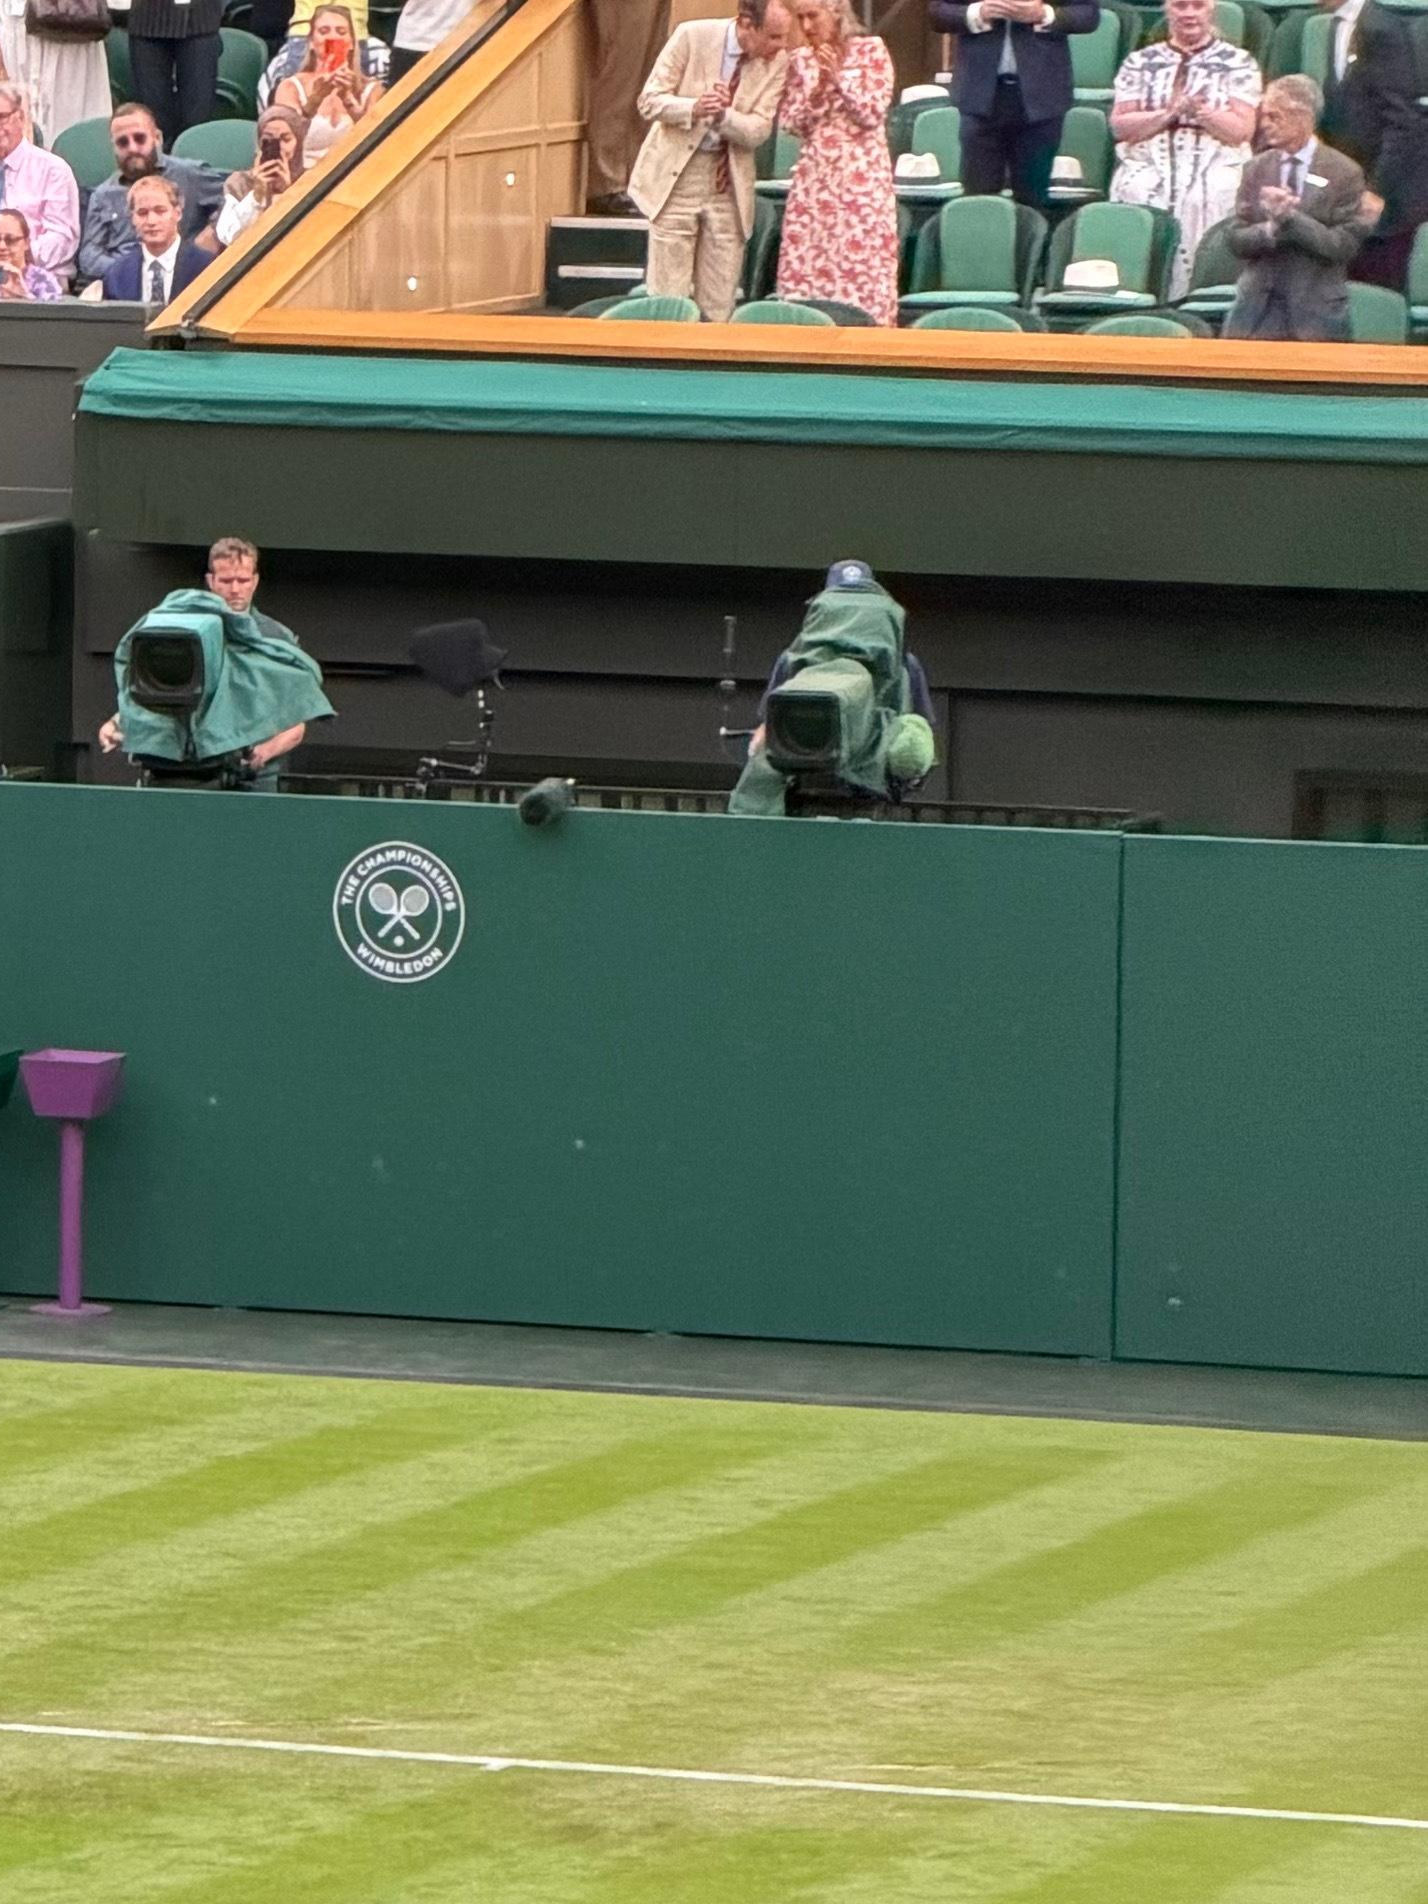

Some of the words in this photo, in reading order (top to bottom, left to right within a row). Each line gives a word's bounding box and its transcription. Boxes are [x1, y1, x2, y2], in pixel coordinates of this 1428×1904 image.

[342, 876, 361, 906] THE
[357, 850, 456, 911] CHAMPIONSHIPS
[357, 942, 443, 974] WIMBLEDON
